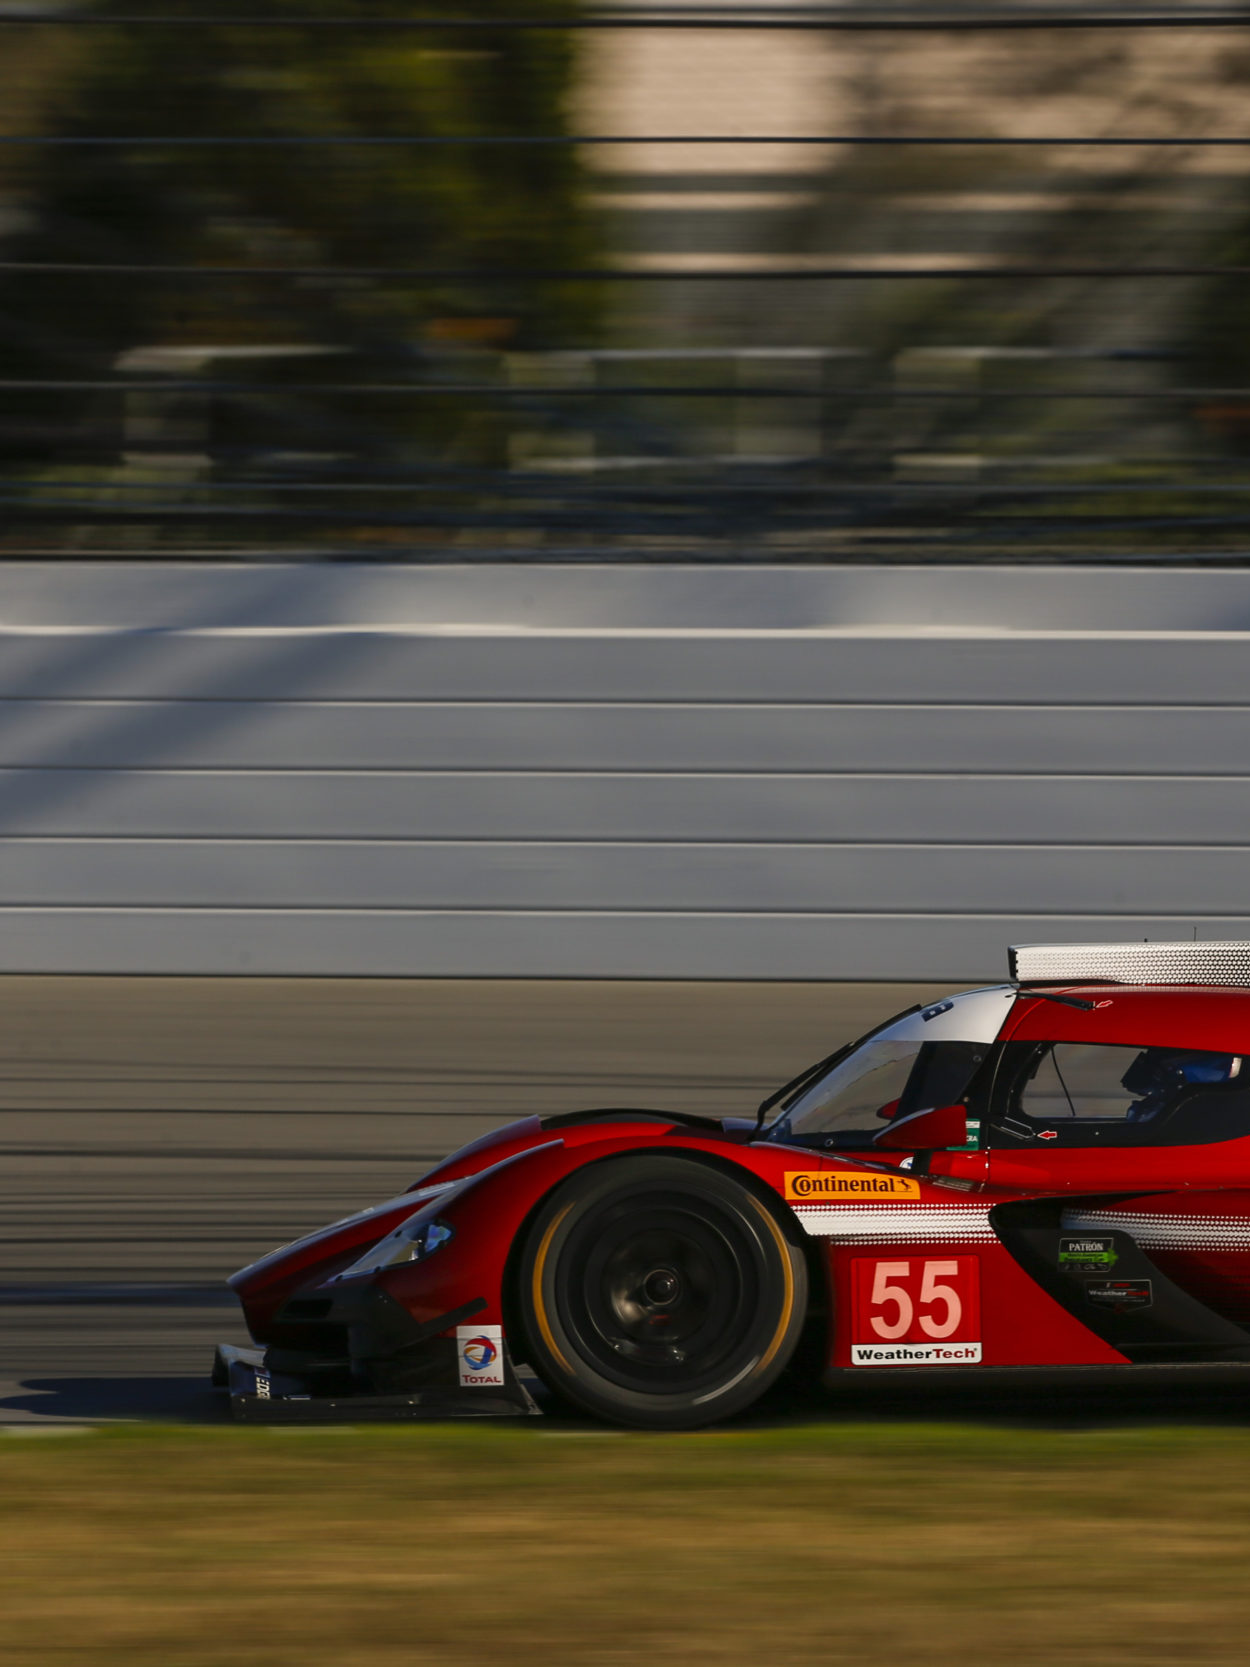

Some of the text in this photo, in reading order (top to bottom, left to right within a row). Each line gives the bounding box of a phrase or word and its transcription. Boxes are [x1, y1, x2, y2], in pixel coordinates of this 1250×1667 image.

[792, 1175, 896, 1196] Continental
[870, 1260, 962, 1339] 55
[461, 1374, 502, 1384] TOTAL
